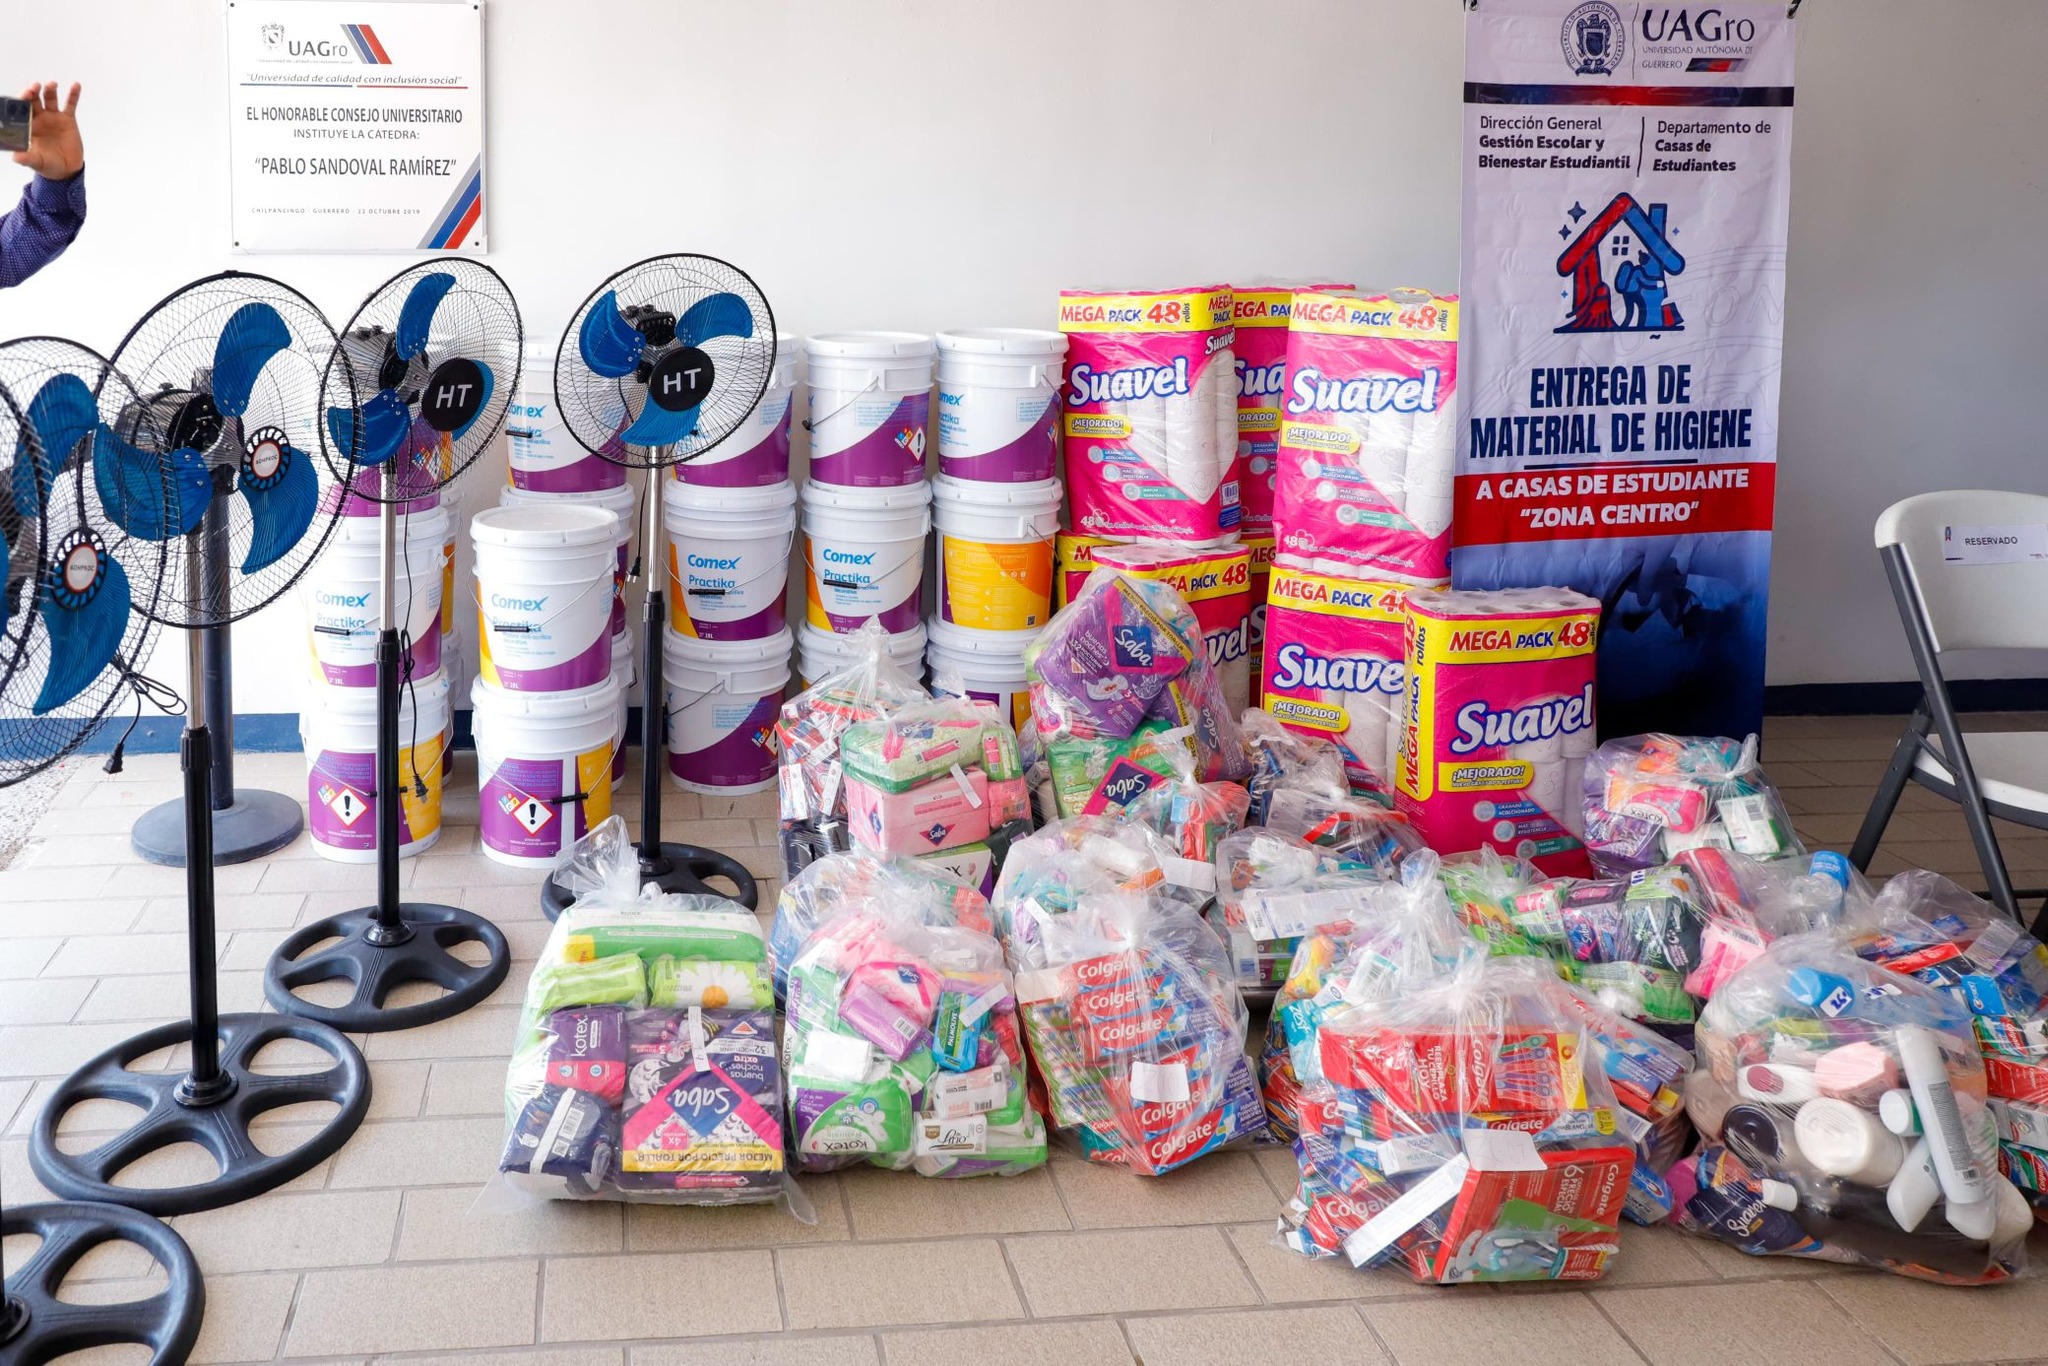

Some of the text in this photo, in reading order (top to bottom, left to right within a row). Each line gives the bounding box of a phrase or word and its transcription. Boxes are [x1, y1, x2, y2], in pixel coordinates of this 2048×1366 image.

[1642, 9, 1755, 42] UAGro
[288, 40, 348, 58] UAGro
[1642, 46, 1694, 54] UNIVERSIDAD
[1696, 45, 1744, 54] AUTÓNOMA
[1642, 61, 1683, 69] GUERRERO
[312, 74, 324, 83] de
[325, 74, 363, 84] calidad
[383, 75, 428, 85] inclusión
[247, 106, 463, 124] EL HONORABLE CONSEJO UNIVERSITARIO
[1480, 116, 1602, 131] Dirección General
[293, 128, 421, 141] INSTITUYE LA CÁTEDRA:
[1657, 120, 1771, 137] Departamento de
[1479, 135, 1605, 152] Gestión Escolar y
[1654, 140, 1712, 153] Casas de
[309, 158, 387, 176] SANDOVAL
[1479, 156, 1631, 170] Bienestar Estudiantil
[1652, 159, 1737, 172] Estudiantes
[1061, 301, 1191, 324] MEGA PACK 48 rollos
[1208, 294, 1234, 312] MEGA
[1234, 300, 1268, 318] EGA
[1213, 310, 1231, 324] PACK
[1292, 301, 1449, 333] MEGA PACK 48 rollos
[662, 366, 703, 395] HT
[1068, 355, 1190, 406] Suavel
[1287, 366, 1440, 414] Suavel
[1530, 364, 1692, 409] ENTREGA DE
[435, 384, 473, 409] HT
[1071, 417, 1124, 430] ¡MEJORADO!
[1287, 427, 1351, 443] ¡MEJORADO!
[1469, 408, 1753, 459] MATERIAL DE HIGIENE
[1475, 468, 1750, 500] A CASAS DE ESTUDIANTE
[1964, 536, 2018, 546] RESERVADO
[687, 553, 742, 570] Comex
[823, 548, 877, 565] Comex
[688, 574, 736, 589] Practika
[824, 568, 871, 584] Practika
[1190, 562, 1248, 589] PACK 48
[315, 590, 372, 608] Comex
[491, 593, 549, 611] Comex
[1273, 580, 1328, 604] MEGA
[1332, 589, 1374, 609] PACK
[1139, 604, 1157, 623] PRECIO
[1084, 629, 1108, 655] buenas
[1204, 615, 1248, 666] vel
[1417, 625, 1427, 667] rollos
[1449, 621, 1591, 652] MEGA PACK 48
[1080, 636, 1104, 660] noches
[1114, 628, 1153, 667] Saba
[1273, 642, 1406, 694] Suave
[1408, 674, 1420, 724] PACK
[1273, 701, 1340, 720] ¡MEJORADO!
[1449, 682, 1595, 756] Suavel
[1202, 704, 1220, 749] Saba
[1405, 726, 1419, 794] MEGA
[1452, 765, 1525, 782] ¡MEJORADO!
[1105, 773, 1146, 799] Saba
[1629, 808, 1664, 822] kotex
[929, 828, 947, 840] Saba
[1582, 923, 1592, 944] Saba
[570, 1017, 588, 1057] kotex
[947, 1010, 959, 1047] PALMOLIVE
[1100, 1018, 1162, 1042] Colgate
[754, 1044, 767, 1054] 32
[782, 1035, 793, 1068] kotex
[730, 1063, 764, 1072] noches
[733, 1055, 758, 1063] extra
[730, 1072, 764, 1081] buenas
[1417, 1058, 1431, 1089] HOY
[1428, 1062, 1440, 1100] CEPILLO
[1433, 1045, 1448, 1102] REEMPLAZA
[1472, 1038, 1490, 1107] Colgate
[673, 1086, 731, 1117] Saba
[823, 1139, 868, 1152] kotex
[1151, 1122, 1213, 1159] Colgate
[677, 1152, 698, 1162] POR
[699, 1152, 737, 1162] PRECIO
[739, 1152, 773, 1162] MEJOR
[1563, 1164, 1586, 1178] 6
[1553, 1178, 1569, 1213] ESPECIAL
[1562, 1178, 1577, 1211] PRECIO
[1596, 1164, 1619, 1216] Colgate
